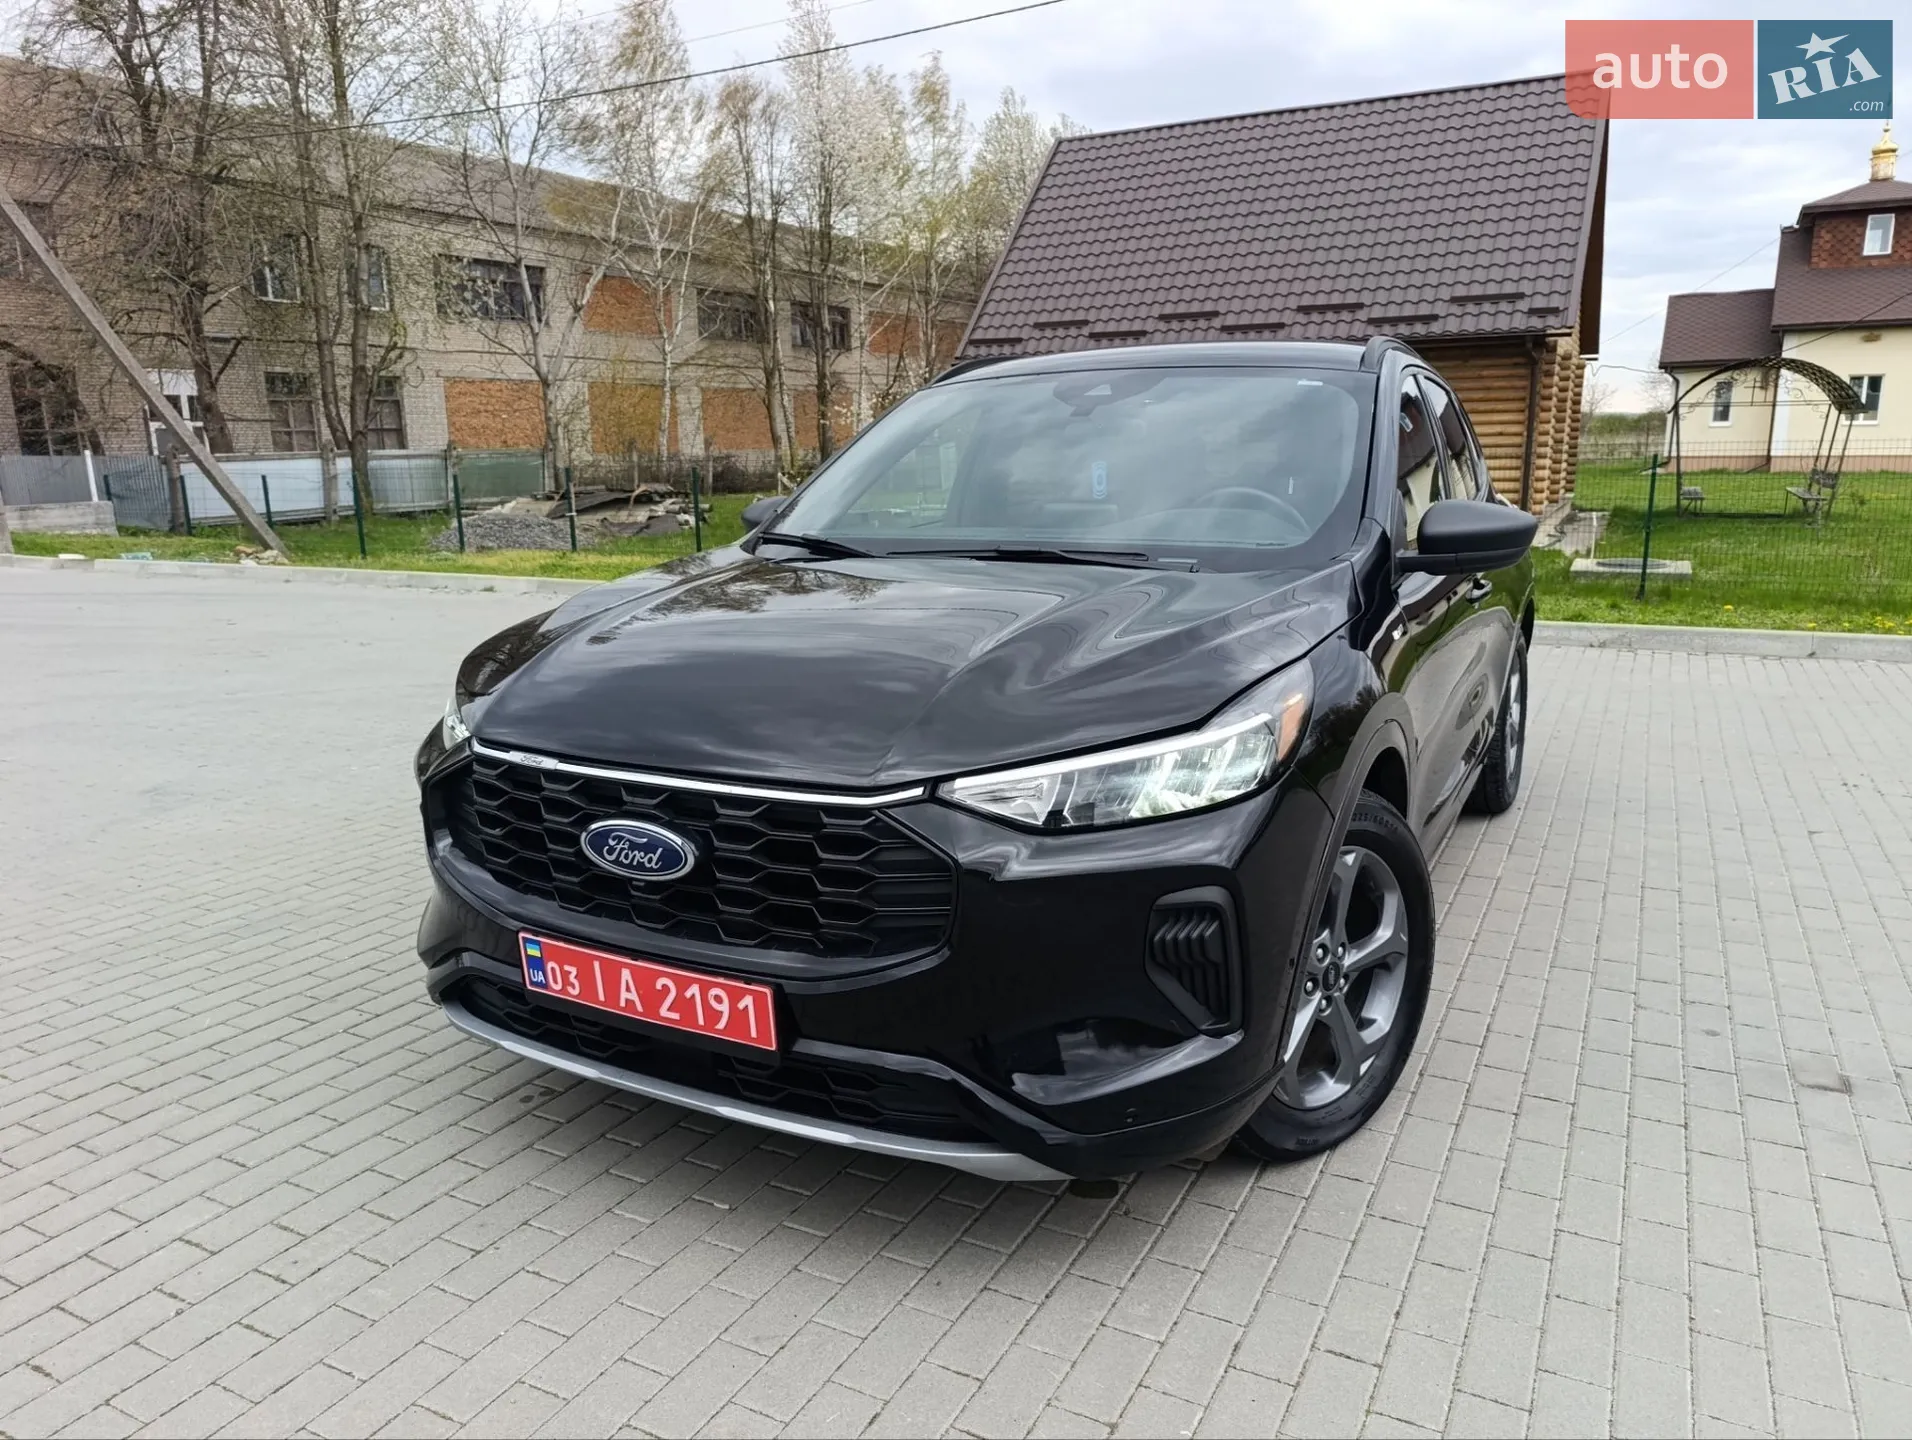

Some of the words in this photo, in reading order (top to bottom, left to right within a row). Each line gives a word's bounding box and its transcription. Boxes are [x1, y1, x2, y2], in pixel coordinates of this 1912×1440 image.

[603, 832, 663, 869] Ford
[530, 968, 546, 984] UA
[547, 961, 580, 996] 03
[655, 977, 757, 1038] 2191
